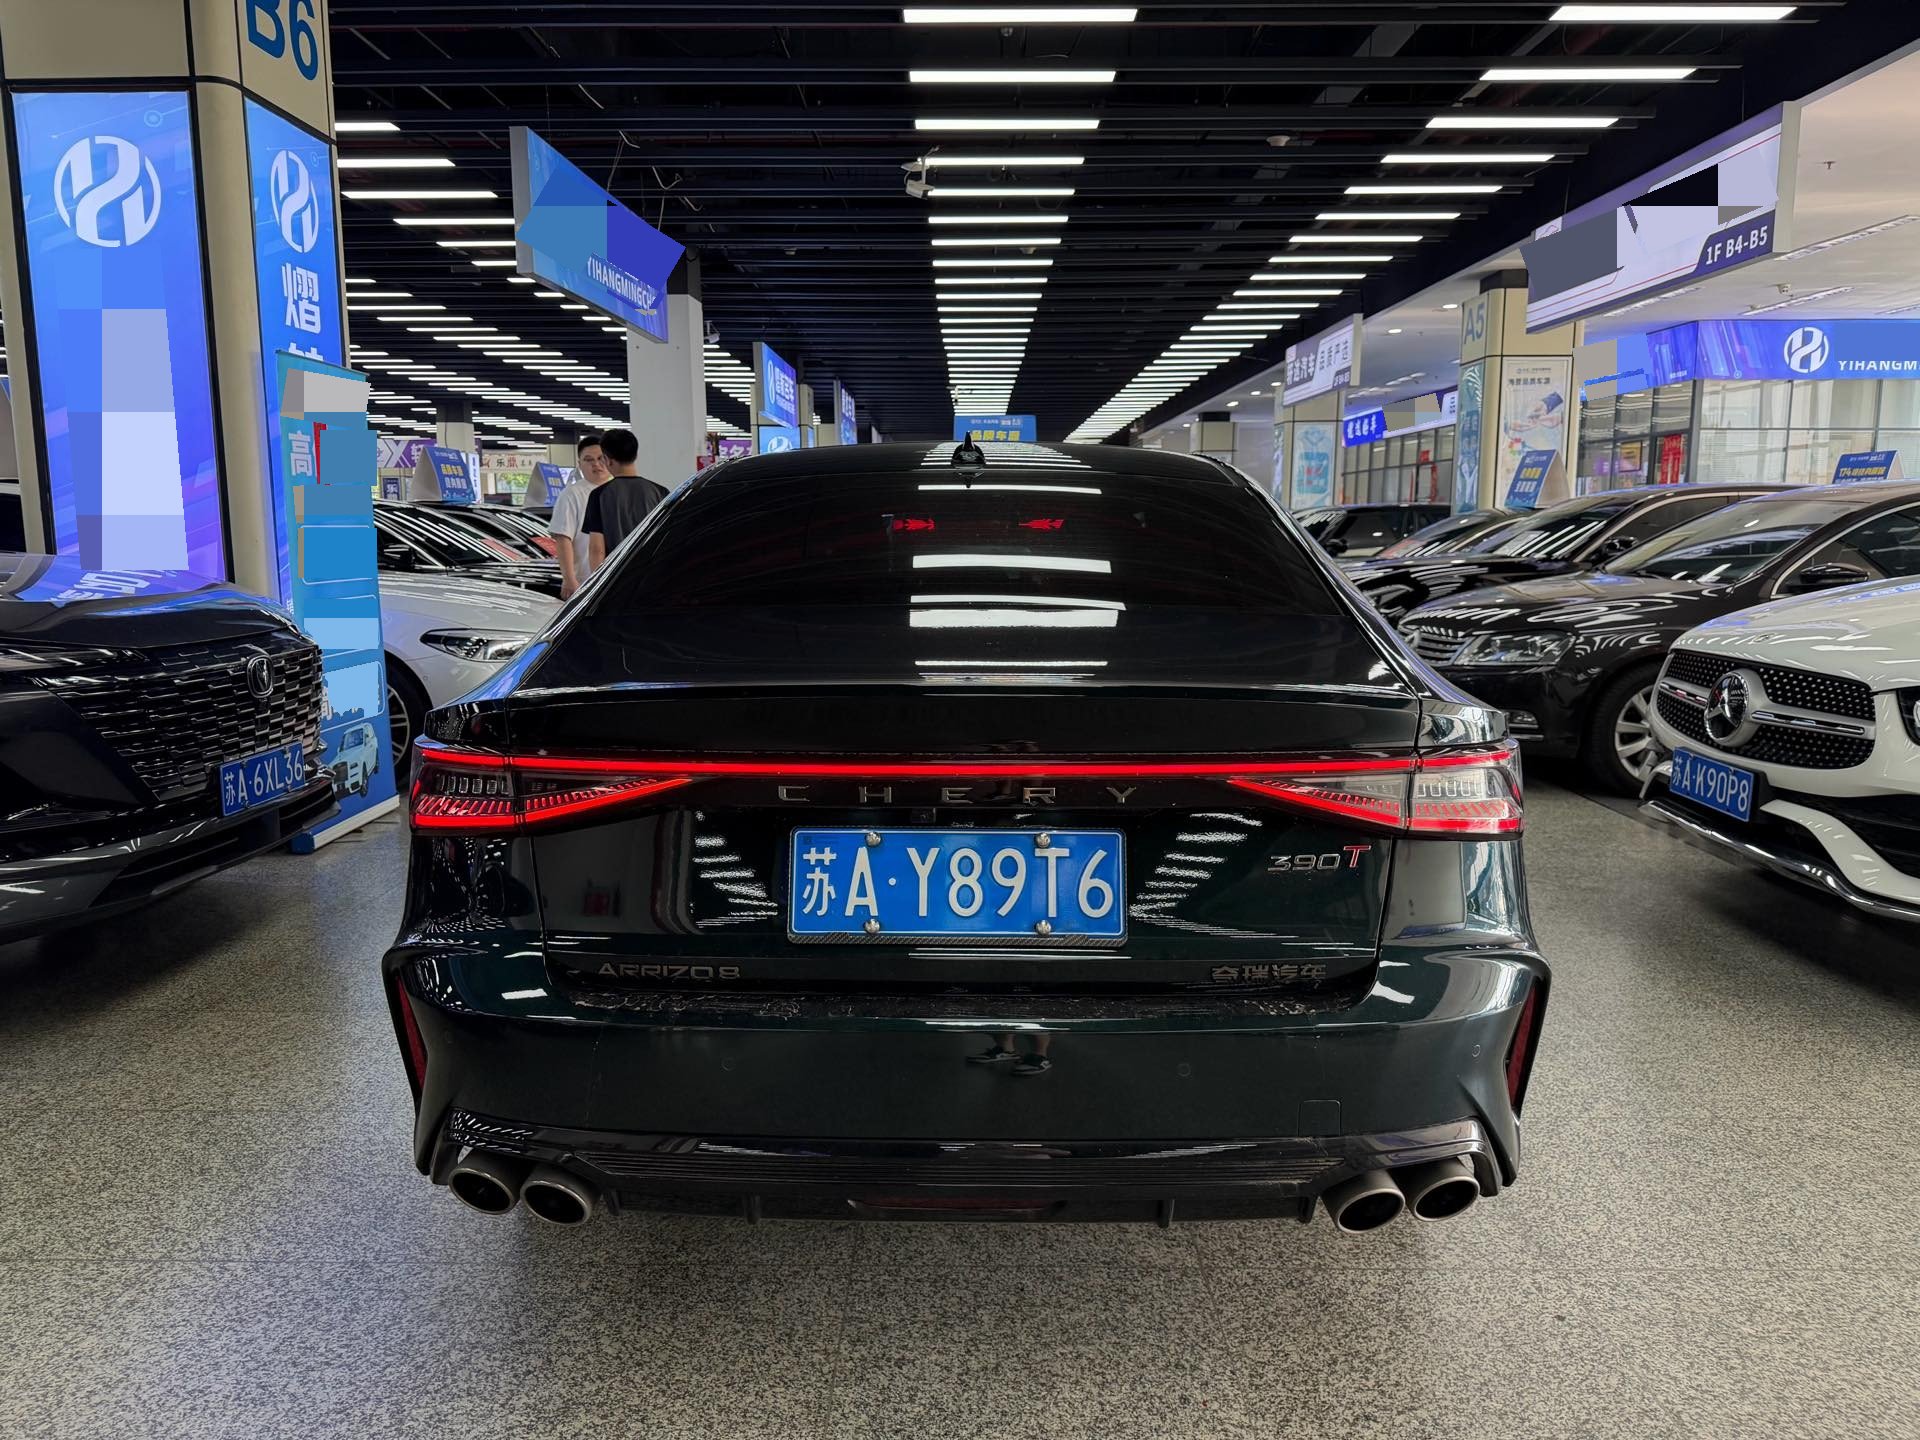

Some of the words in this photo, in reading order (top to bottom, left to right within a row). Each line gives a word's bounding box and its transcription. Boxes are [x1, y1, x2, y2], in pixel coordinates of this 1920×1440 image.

[1706, 243, 1722, 265] 1F
[1726, 225, 1768, 258] B4-B5
[587, 256, 656, 310] YIHANGMINGCH
[1464, 304, 1485, 344] A5
[778, 785, 1136, 804] CHERY
[1267, 845, 1371, 872] 390T
[802, 847, 1114, 918] 苏A·Y89T6
[599, 962, 714, 980] ARRIZO
[719, 966, 740, 979] 8
[1211, 964, 1327, 984] 奇瑞汽车
